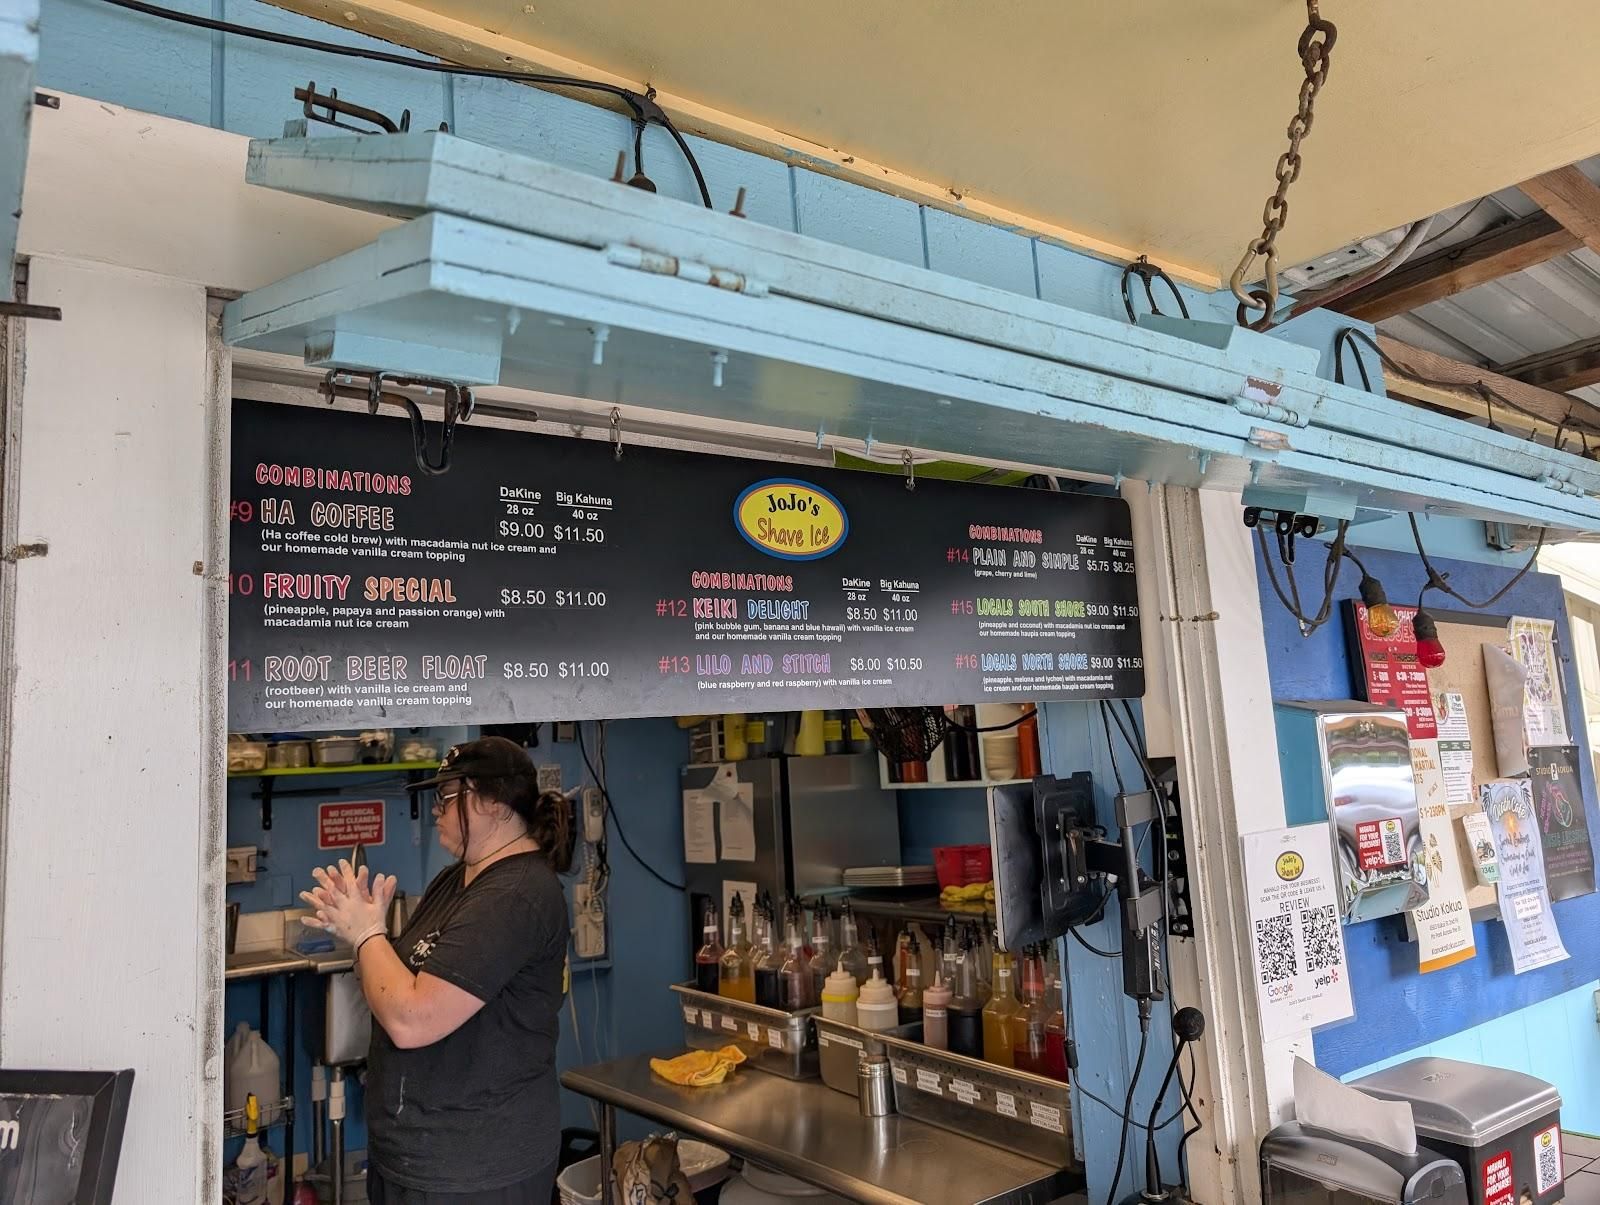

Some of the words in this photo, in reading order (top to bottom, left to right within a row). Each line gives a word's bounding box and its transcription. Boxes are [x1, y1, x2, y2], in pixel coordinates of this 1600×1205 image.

[255, 463, 411, 495] COMBINATIONS
[500, 486, 541, 500] DaKine
[556, 491, 573, 505] Big
[575, 493, 612, 505] Kahuna
[507, 504, 519, 514] 28
[522, 507, 534, 515] oz
[572, 509, 584, 519] 40
[766, 492, 821, 517] JoJo's
[261, 499, 295, 525] HA
[310, 502, 394, 530] COFFEE
[499, 520, 544, 538] $9.00
[554, 524, 604, 543] $11.50
[757, 517, 804, 547] Shave
[810, 524, 830, 547] Ice
[261, 529, 281, 541] (Ha
[285, 531, 321, 541] coffee
[324, 533, 348, 543] cold
[352, 534, 382, 547] brew)
[385, 537, 407, 546] with
[411, 539, 469, 549] macadamia
[472, 542, 488, 550] nut
[491, 542, 505, 551] ice
[507, 545, 536, 553] cream
[539, 546, 556, 554] and
[261, 544, 282, 552] our
[285, 543, 348, 555] homemade
[351, 547, 387, 557] vanilla
[390, 550, 423, 558] cream
[426, 550, 465, 563] topping
[264, 573, 351, 600] FRUITY
[364, 576, 456, 603] SPECIAL
[501, 588, 546, 605] $8.50
[556, 590, 606, 607] $11.00
[692, 571, 793, 592] COMBINATIONS
[842, 578, 871, 588] DaKine
[880, 579, 893, 590] Big
[893, 580, 920, 590] Kahuna
[847, 592, 856, 600] 28
[892, 593, 900, 602] 40
[264, 603, 329, 616] (pineapple,
[333, 607, 372, 617] papaya
[375, 607, 395, 615] and
[399, 607, 440, 618] passion
[443, 608, 482, 619] orange)
[484, 609, 505, 617] with
[656, 599, 687, 617] #12
[693, 598, 737, 619] KEIKI
[747, 599, 809, 620] DELIGHT
[847, 607, 877, 621] $8.50
[883, 608, 917, 621] $11.00
[264, 617, 331, 627] macadamia
[335, 619, 353, 627] nut
[356, 618, 372, 628] ice
[376, 620, 409, 628] cream
[695, 622, 714, 631] (pink
[716, 622, 741, 630] bubble
[743, 624, 762, 632] gum,
[806, 623, 820, 631] blue
[822, 624, 846, 632] hawaii)
[695, 631, 710, 640] and
[727, 632, 767, 640] homemade
[816, 633, 842, 642] topping
[265, 655, 332, 682] ROOT
[347, 655, 407, 681] BEER
[422, 655, 487, 680] FLOAT
[504, 662, 549, 680] $8.50
[559, 662, 609, 679] $11.00
[659, 656, 690, 673] #13
[696, 654, 731, 676] LILO
[741, 654, 774, 674] AND
[782, 653, 831, 674] STITCH
[850, 657, 880, 672] $8.00
[887, 658, 922, 671] $10.50
[265, 685, 324, 697] (rootbeer)
[354, 684, 391, 694] vanilla
[394, 684, 409, 693] ice
[413, 685, 445, 693] cream
[448, 683, 467, 692] and
[698, 681, 717, 691] (blue
[719, 680, 755, 690] raspberry
[786, 679, 821, 688] raspberry)
[823, 678, 837, 686] with
[265, 701, 286, 709] our
[289, 697, 353, 708] homemade
[356, 696, 393, 708] vanilla
[396, 697, 429, 705] cream
[432, 695, 472, 706] topping
[1364, 855, 1378, 867] yelp
[1279, 897, 1310, 913] REVIEW
[1416, 904, 1440, 922] Studio
[1440, 900, 1463, 916] Kokua
[1267, 981, 1294, 997] Google
[1314, 974, 1331, 989] yelp
[1487, 1173, 1497, 1186] FOR
[1497, 1166, 1510, 1181] YOUR
